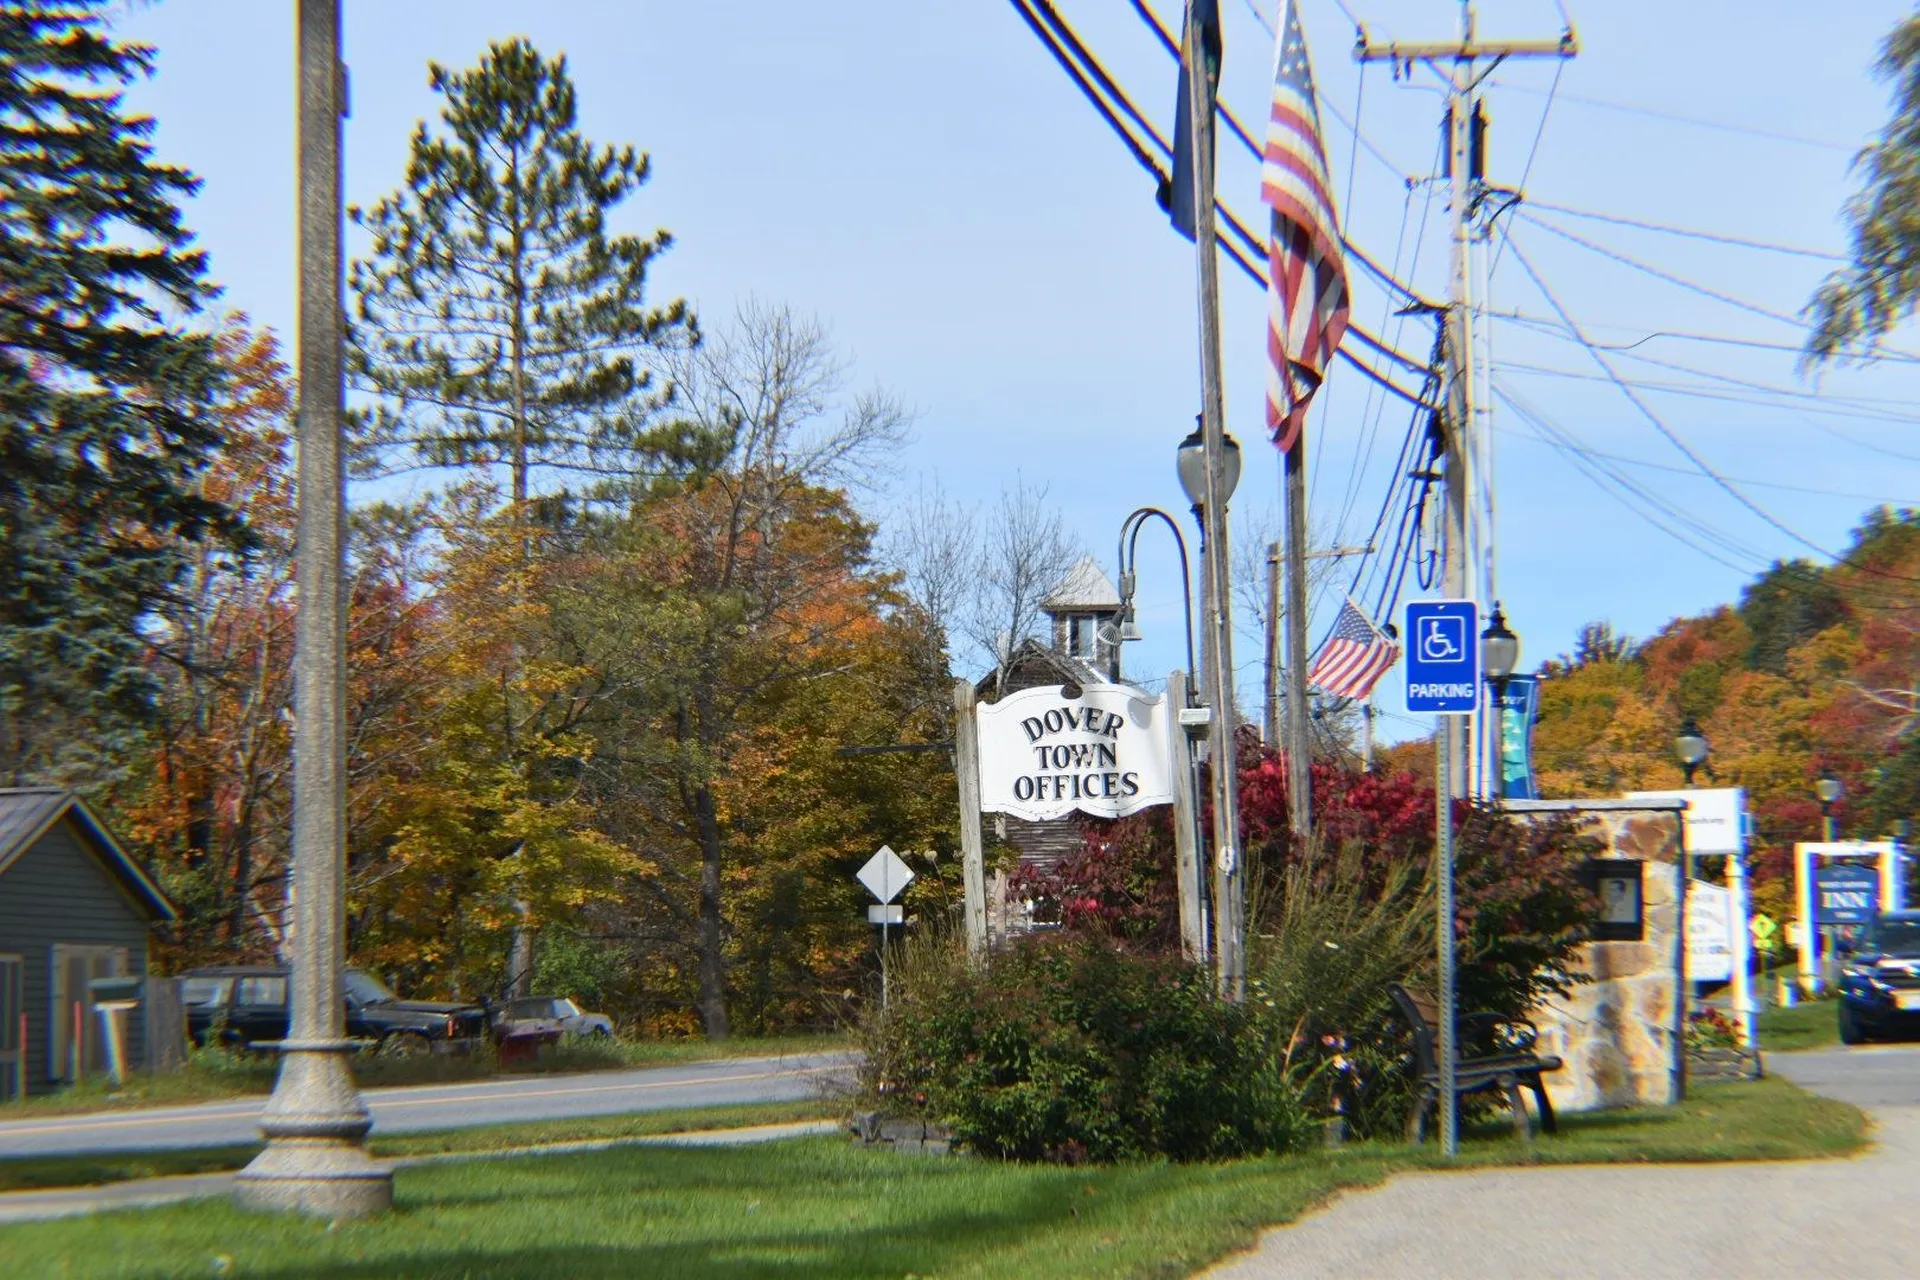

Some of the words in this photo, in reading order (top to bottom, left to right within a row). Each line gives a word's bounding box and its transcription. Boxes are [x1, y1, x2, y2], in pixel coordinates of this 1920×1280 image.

[1409, 683, 1474, 698] PARKING
[1020, 706, 1124, 744] DOVER
[1034, 743, 1117, 770] TOWN
[1012, 772, 1139, 801] OFFICES
[1822, 892, 1869, 908] INN
